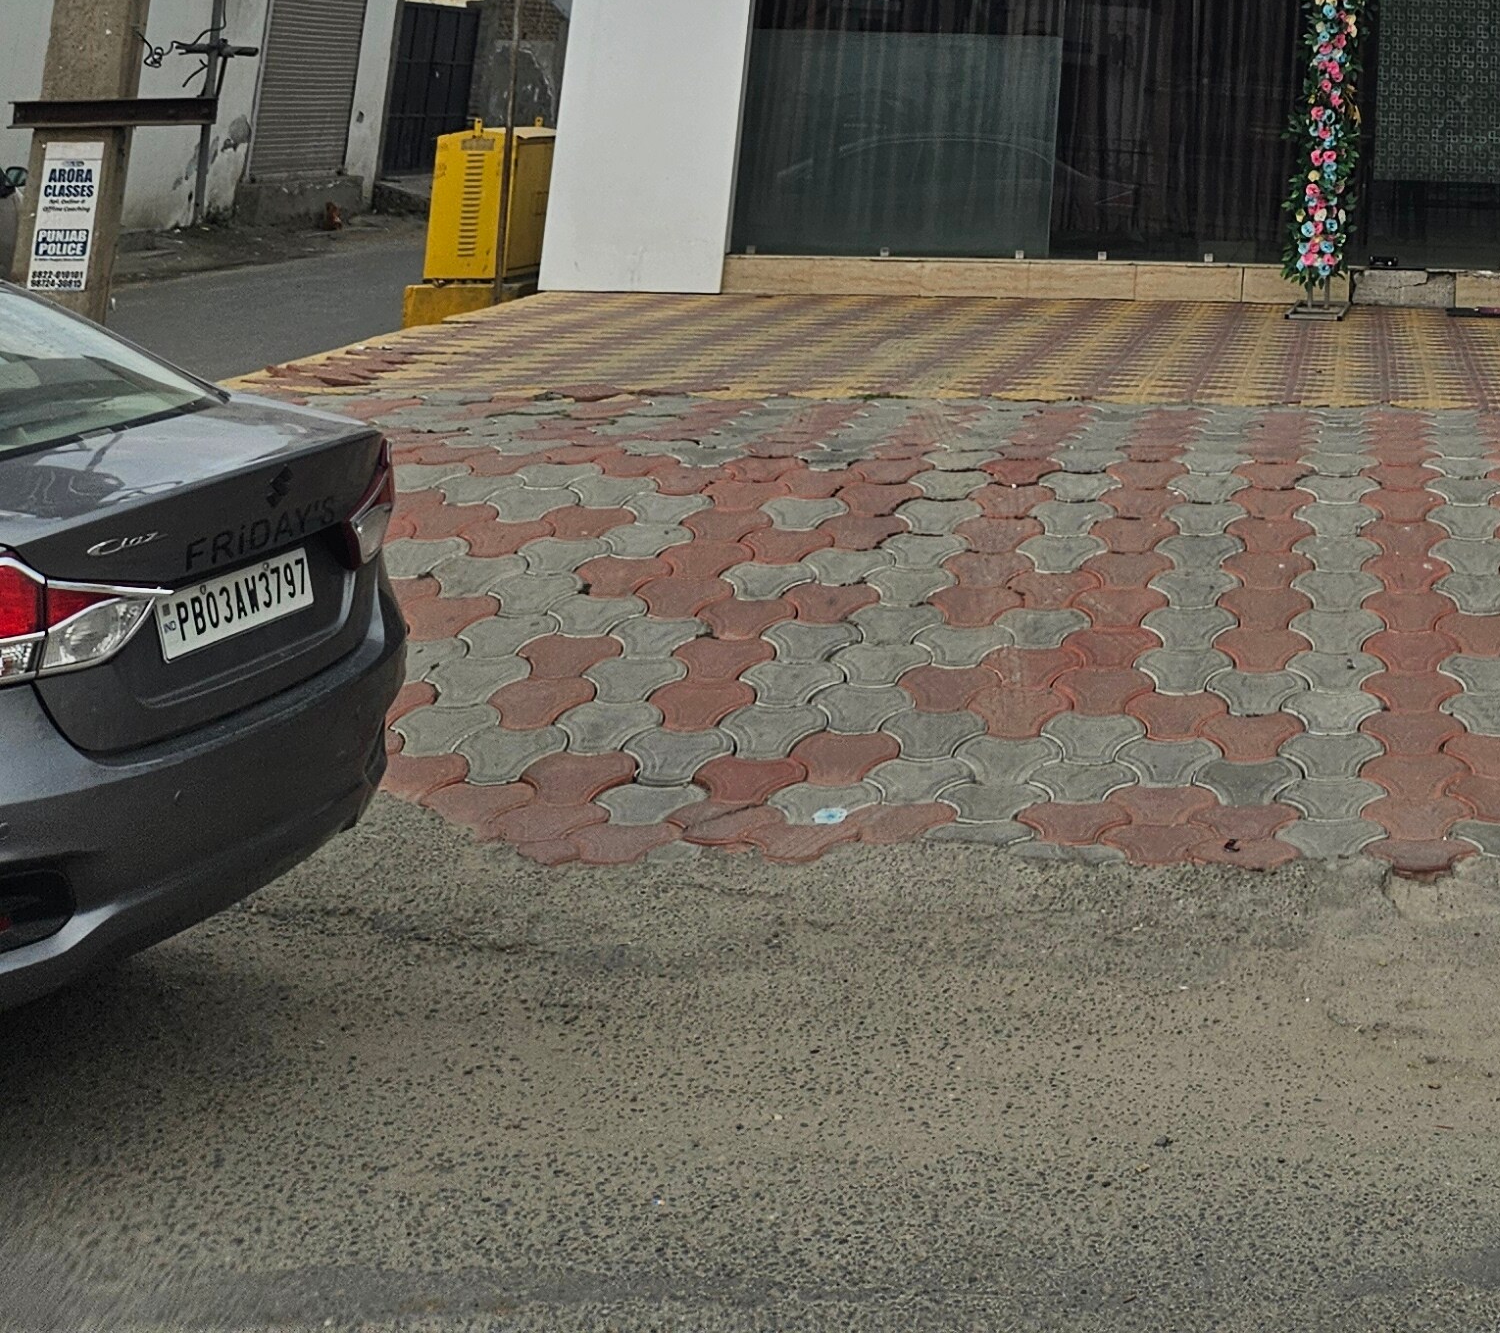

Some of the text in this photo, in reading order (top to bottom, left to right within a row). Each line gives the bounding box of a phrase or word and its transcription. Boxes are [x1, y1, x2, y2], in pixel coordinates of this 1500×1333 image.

[48, 168, 93, 183] ARORA
[44, 184, 95, 198] CLASSES
[38, 230, 88, 243] PUNJAB
[38, 243, 85, 255] POLICE
[175, 557, 307, 642] PB03AW3797
